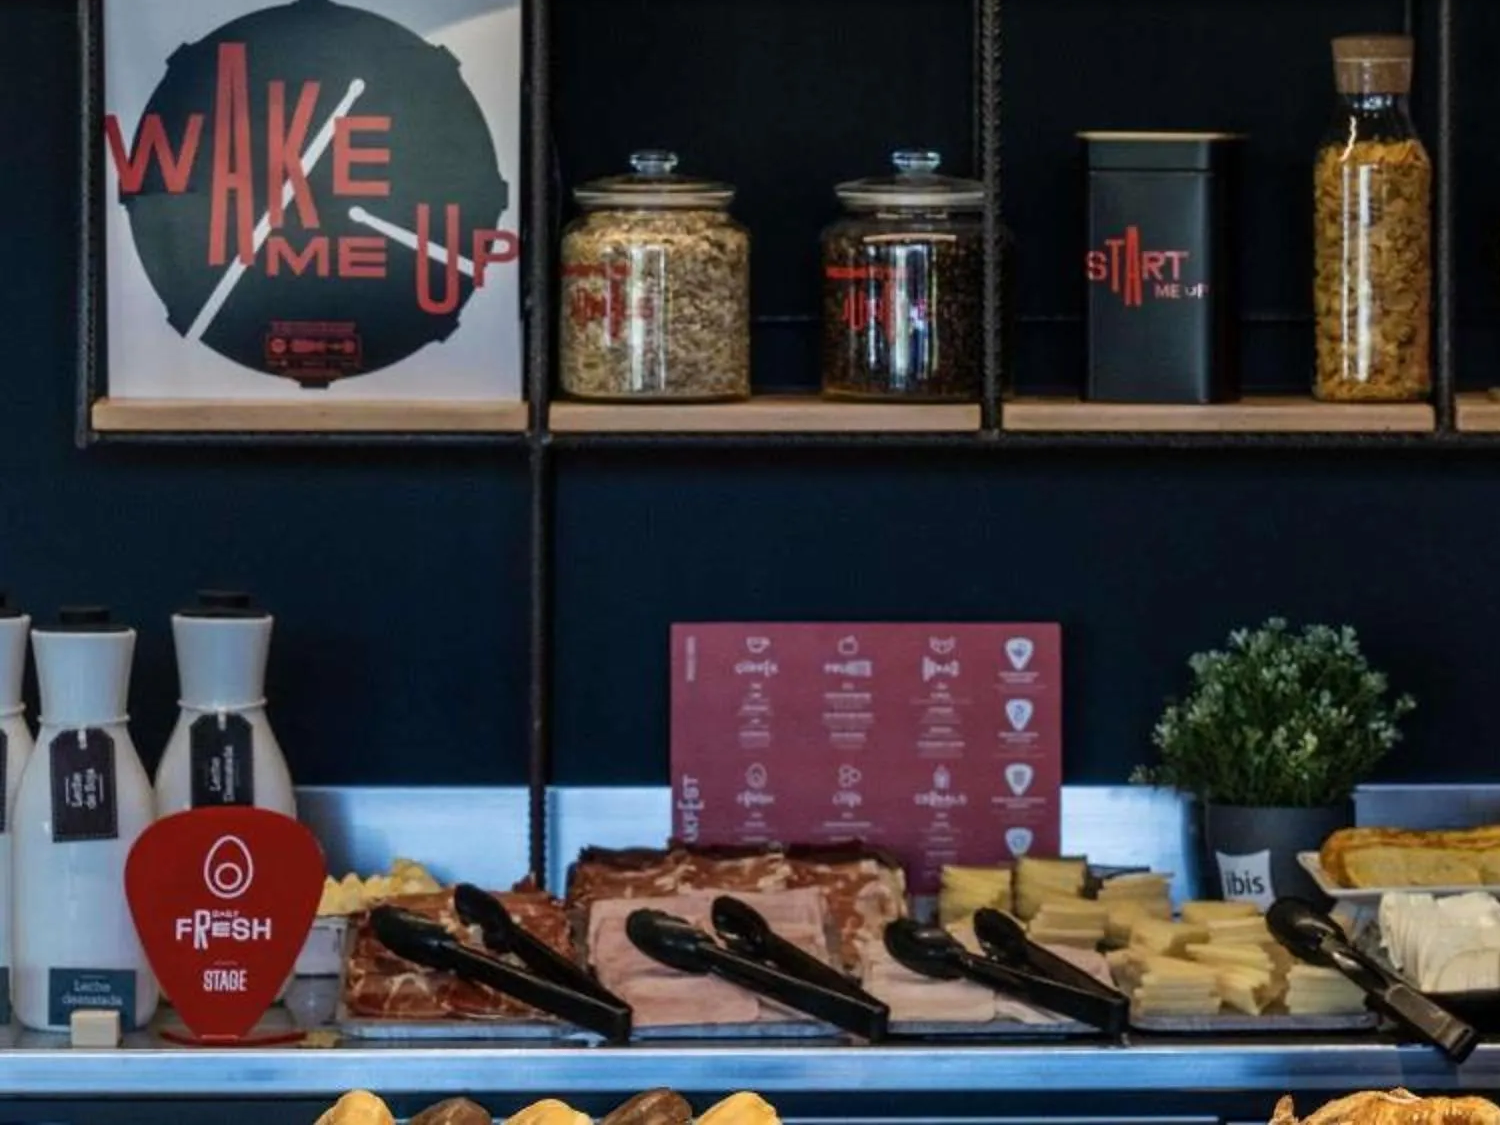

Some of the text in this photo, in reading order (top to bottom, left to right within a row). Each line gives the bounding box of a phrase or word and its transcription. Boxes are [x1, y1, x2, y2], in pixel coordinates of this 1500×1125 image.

[104, 42, 393, 267] WAKE
[266, 236, 388, 278] ME
[416, 203, 520, 315] UP
[1086, 225, 1189, 306] START
[1154, 283, 1181, 299] ME
[1226, 869, 1265, 895] ibis
[176, 909, 272, 951] FRESH
[203, 969, 248, 992] STAGE
